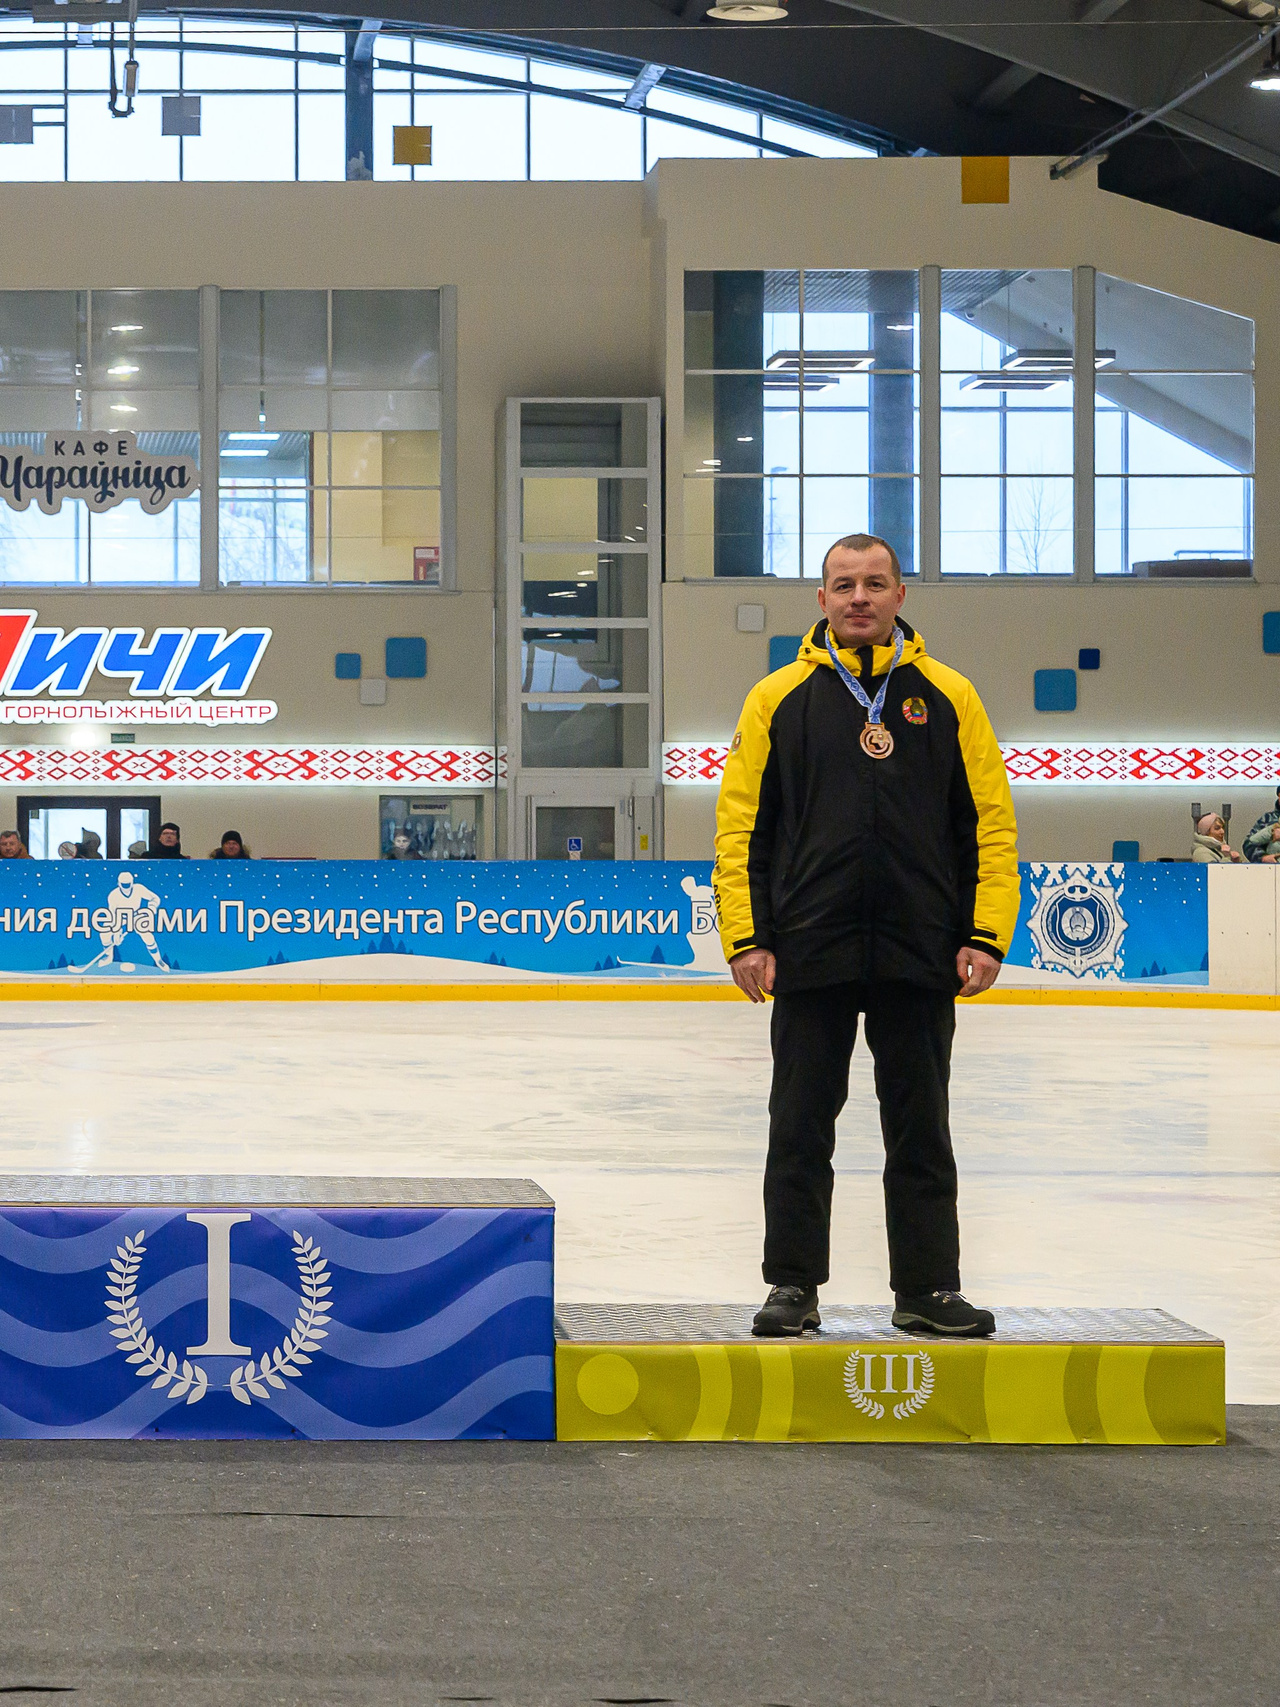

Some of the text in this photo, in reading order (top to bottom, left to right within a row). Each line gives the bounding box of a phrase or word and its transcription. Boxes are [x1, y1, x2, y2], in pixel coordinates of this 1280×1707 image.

[54, 440, 128, 456] КАФЕ
[5, 702, 192, 719] ГОРНОЛЫЖНЫЙ
[199, 705, 272, 721] ЦЕНТР
[66, 907, 208, 939] делами
[219, 900, 444, 942] Президента
[455, 899, 679, 942] Республики
